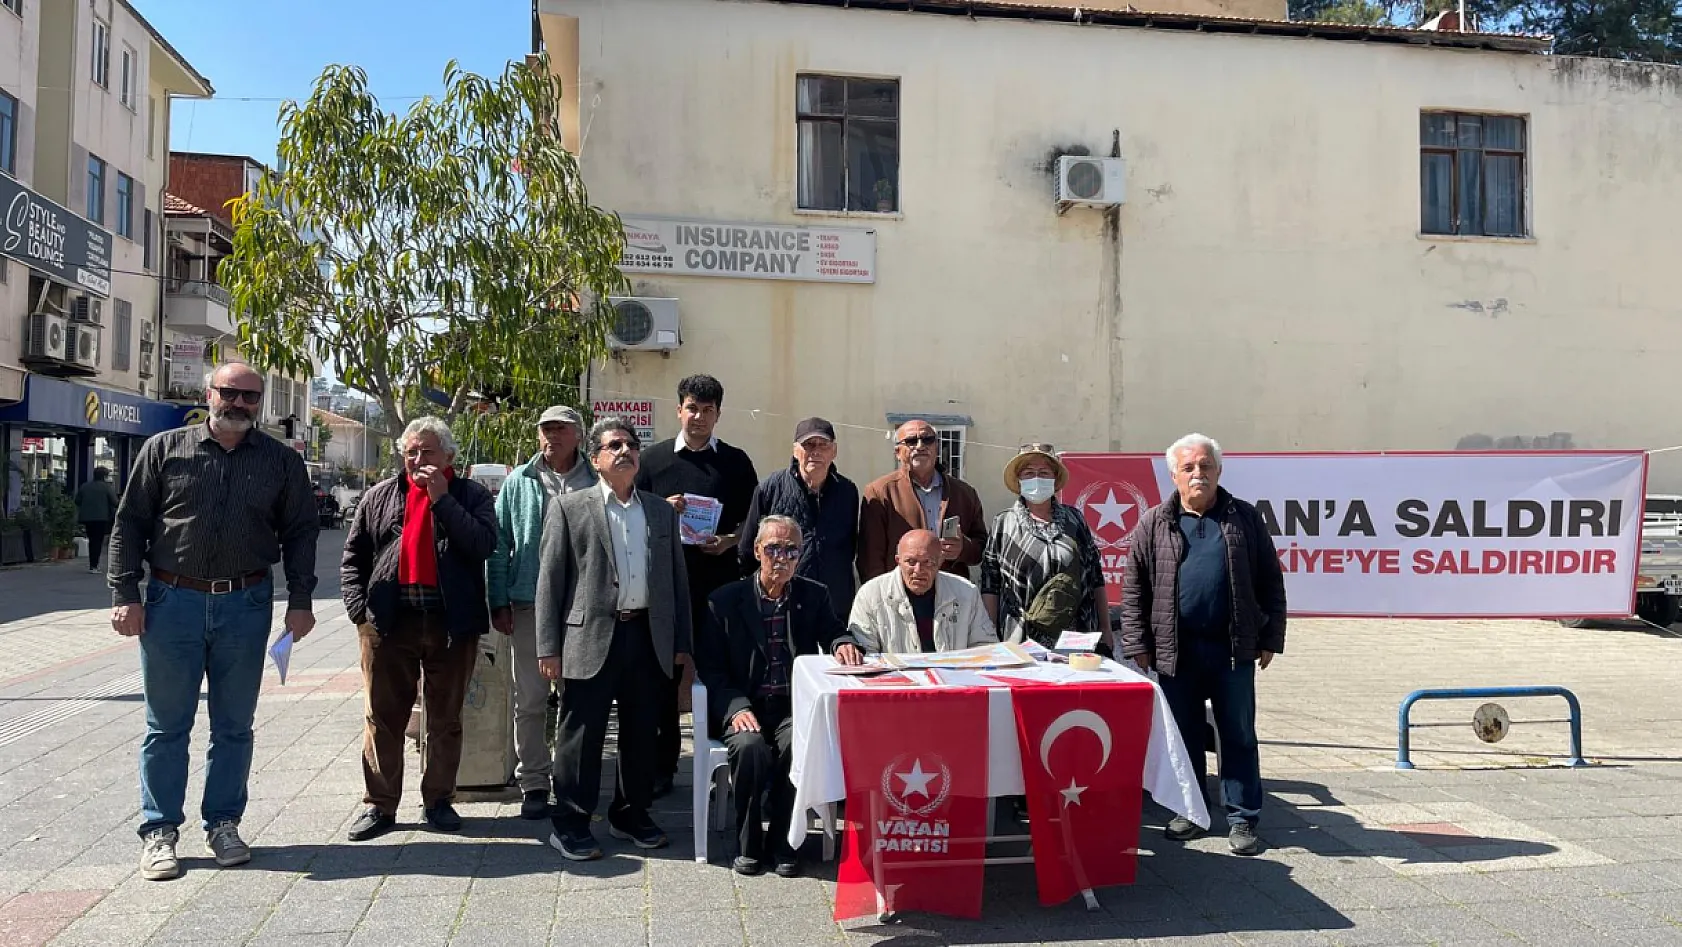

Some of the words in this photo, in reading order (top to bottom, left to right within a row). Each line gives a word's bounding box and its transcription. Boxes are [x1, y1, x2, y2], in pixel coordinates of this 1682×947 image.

[29, 202, 57, 229] STYLE
[28, 220, 65, 251] BEAUTY
[627, 232, 660, 240] NKAYA
[676, 225, 811, 251] INSURANCE
[27, 238, 65, 269] LOUNGE
[684, 249, 800, 273] COMPANY
[102, 401, 141, 424] TURKCELL
[594, 401, 652, 412] AYAKKABI
[1254, 500, 1377, 537] AN'A
[1394, 499, 1623, 537] SALDIRI
[1412, 549, 1616, 575] SALDIRIDIR
[877, 820, 950, 837] VATAN
[875, 838, 950, 854] PARTİSİ
